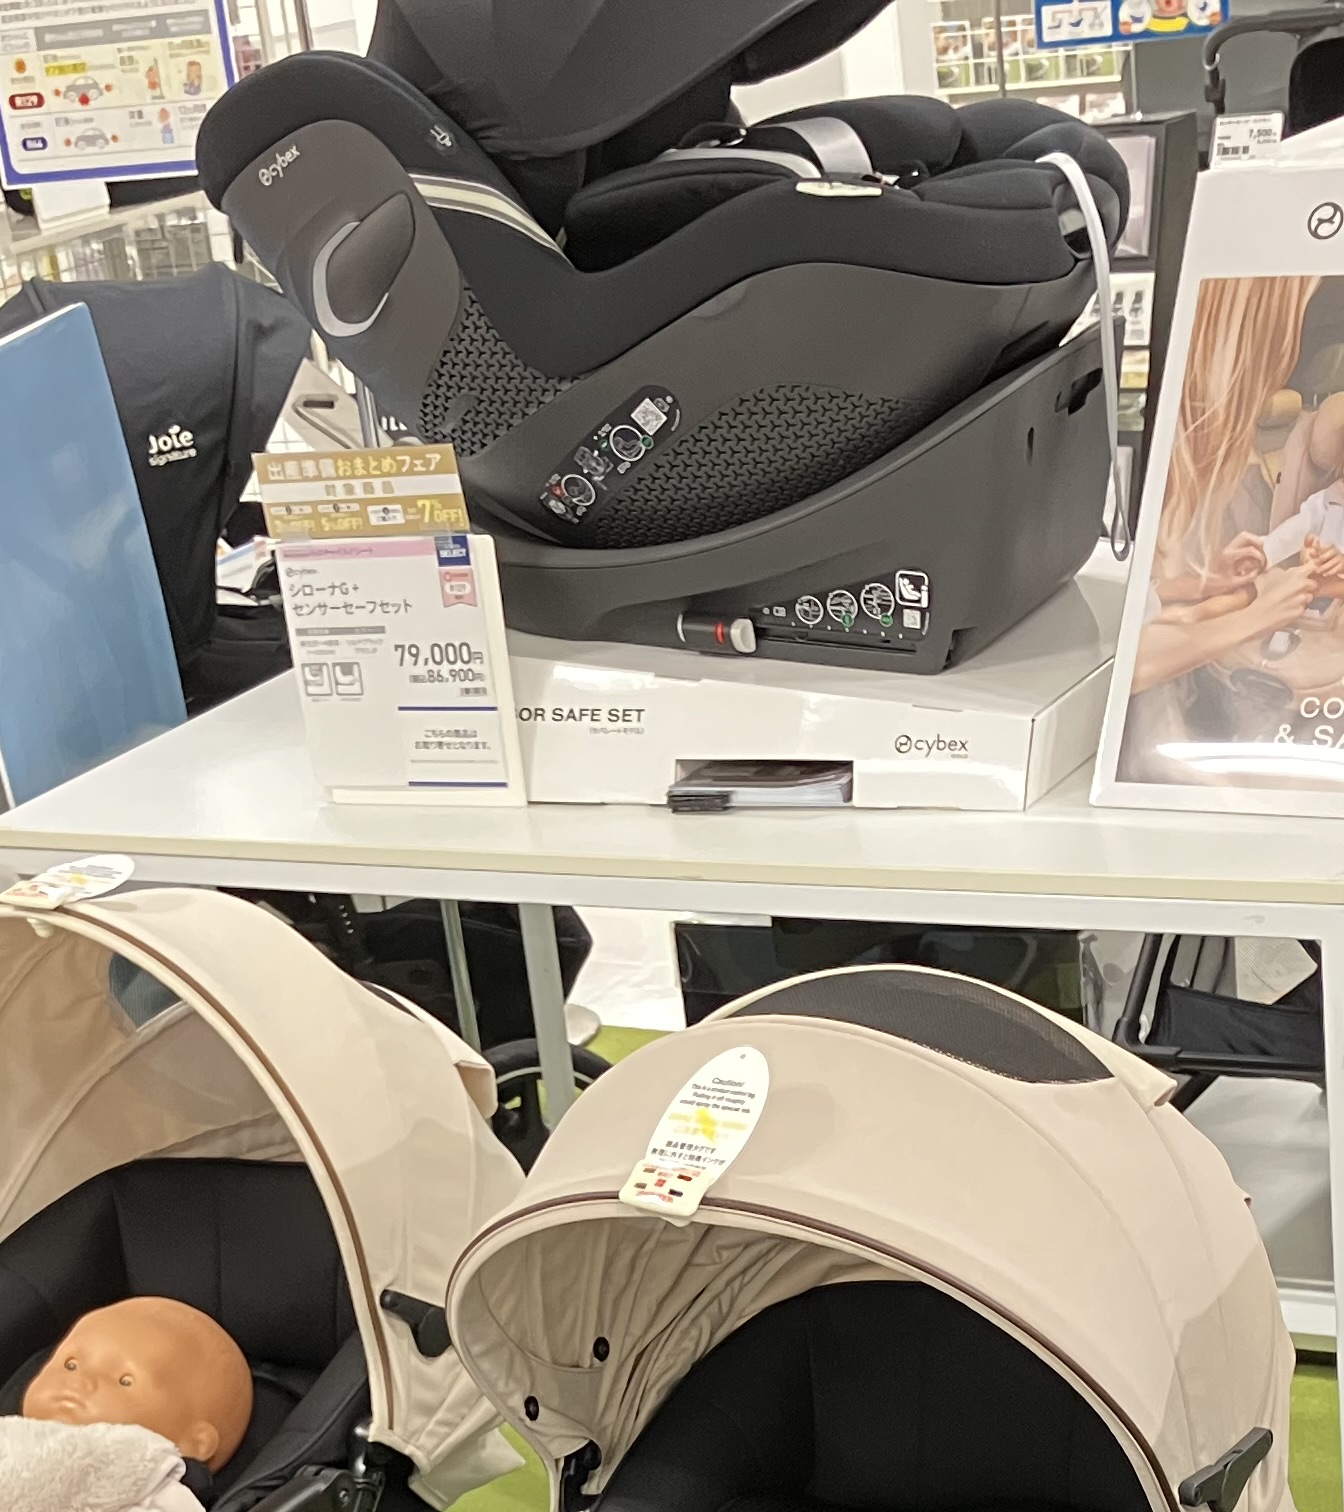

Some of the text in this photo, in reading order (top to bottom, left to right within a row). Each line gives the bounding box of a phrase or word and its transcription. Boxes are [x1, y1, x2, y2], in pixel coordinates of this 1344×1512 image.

[288, 583, 349, 598] シローナG
[292, 599, 413, 617] センサーセーフセット
[394, 642, 485, 667] 79,000円
[515, 707, 646, 723] OR SAFE SET
[1273, 724, 1295, 745] &
[914, 733, 969, 758] cybex
